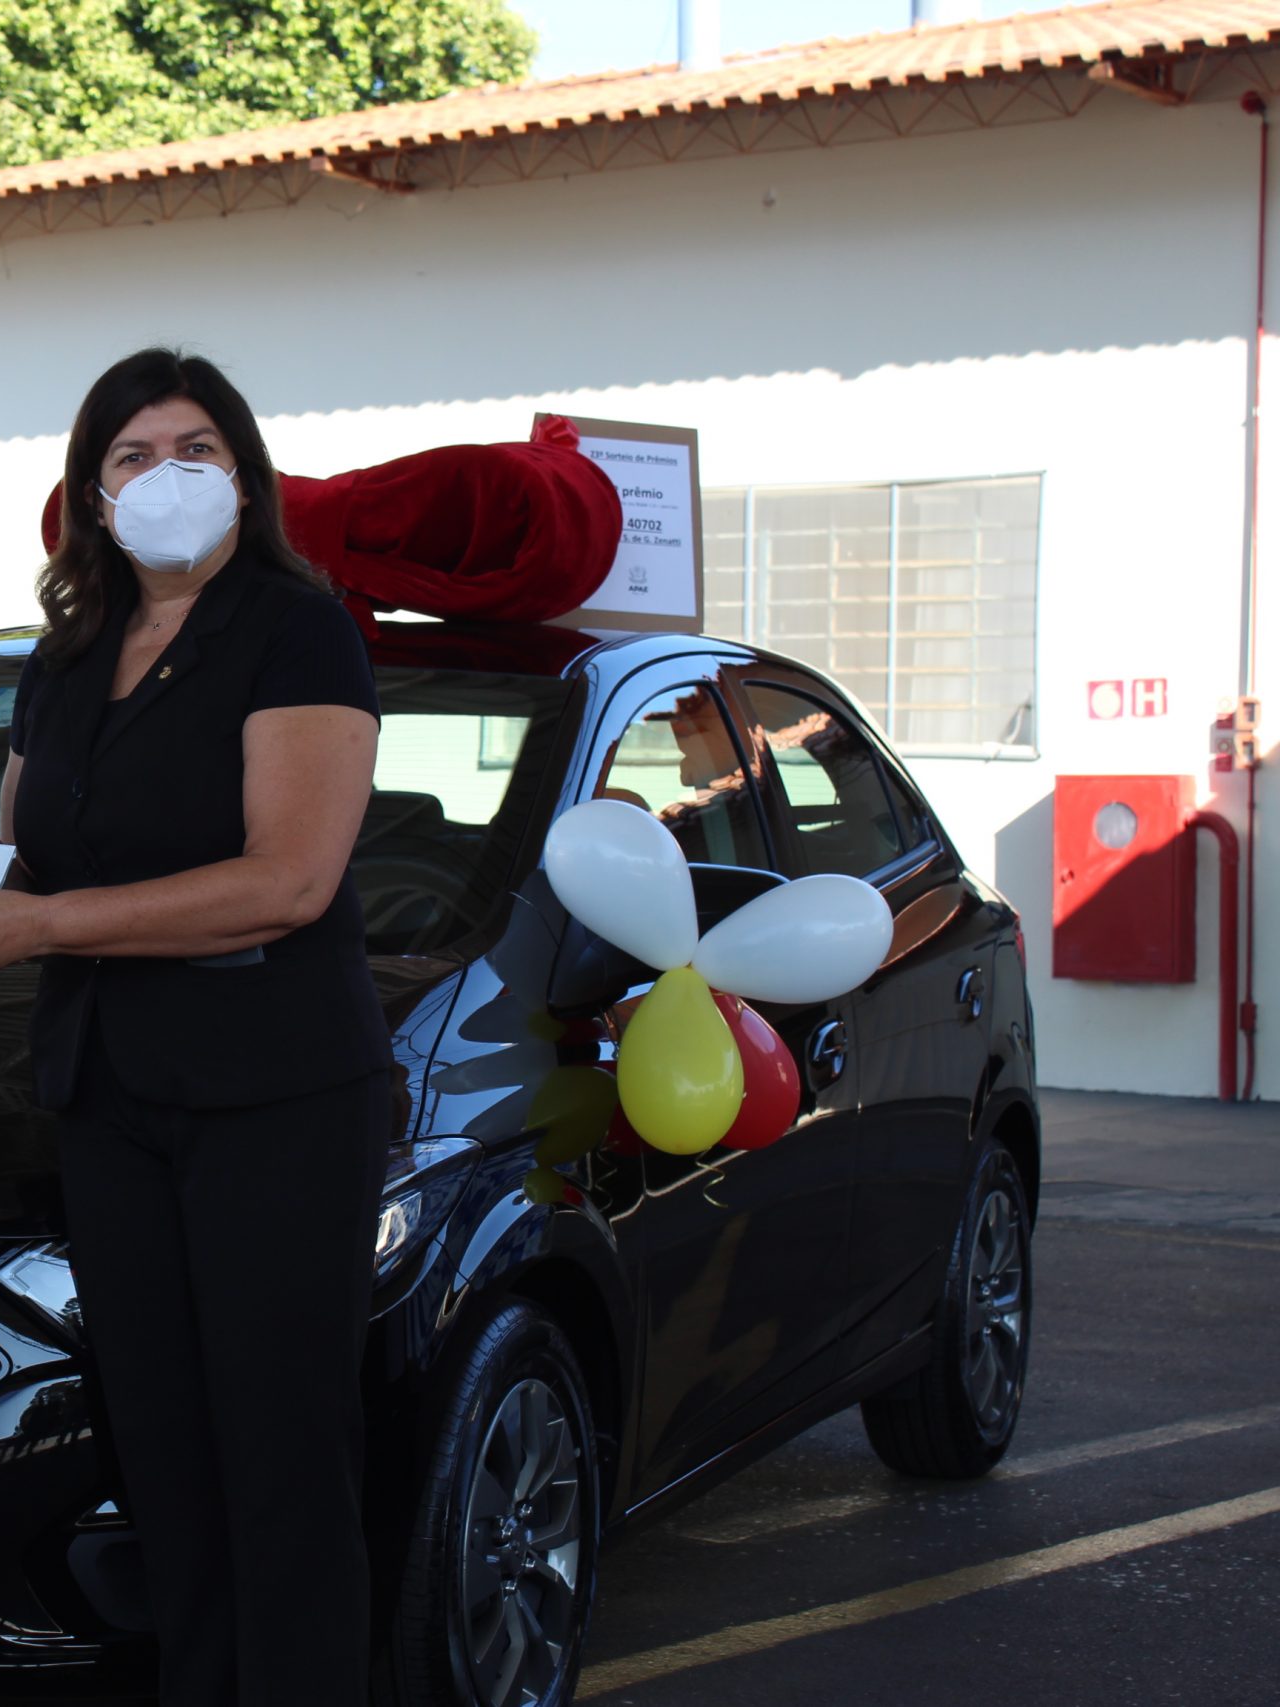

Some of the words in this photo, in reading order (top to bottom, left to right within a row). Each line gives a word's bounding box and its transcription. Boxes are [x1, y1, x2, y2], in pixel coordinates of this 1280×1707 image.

[605, 451, 633, 461] Sorteio
[635, 454, 644, 462] de
[647, 455, 678, 465] Prêmios
[622, 486, 663, 500] prêmio
[627, 518, 662, 531] 40702
[632, 535, 641, 543] de
[1136, 681, 1163, 714] H
